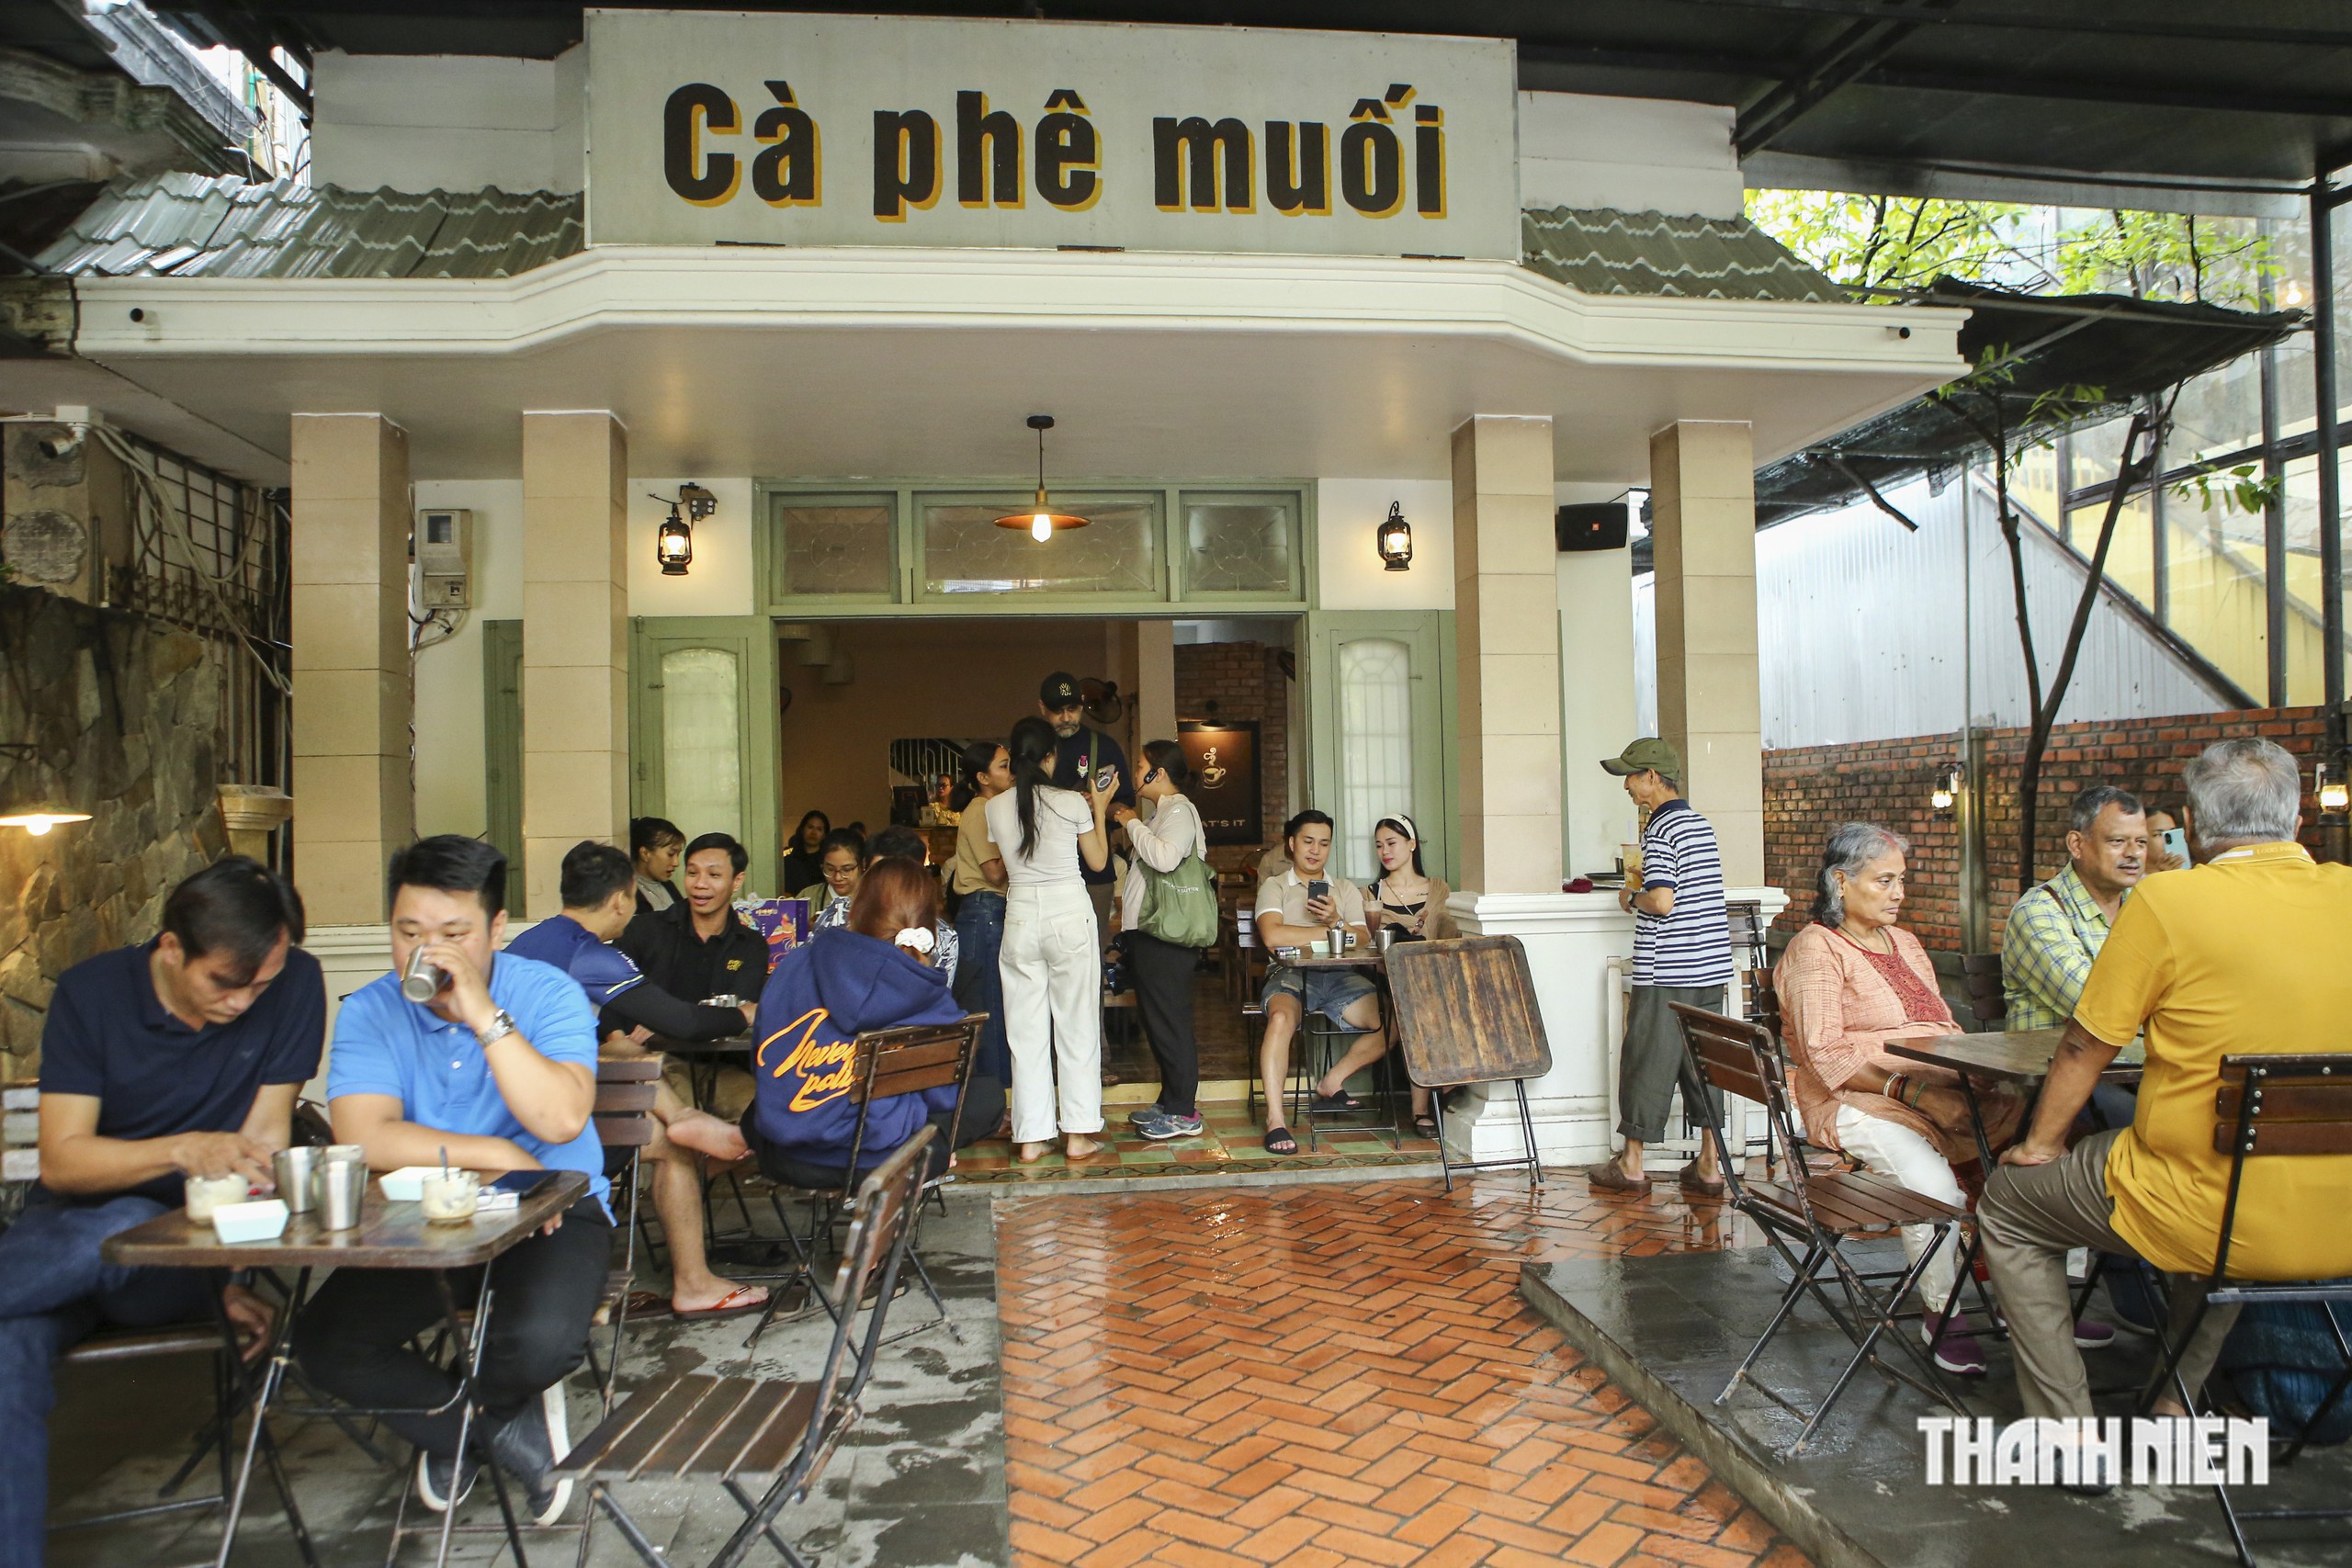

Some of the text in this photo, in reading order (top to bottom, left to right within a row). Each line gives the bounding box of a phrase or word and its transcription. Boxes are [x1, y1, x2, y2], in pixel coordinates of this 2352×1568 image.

[663, 80, 1447, 222] Cà phê muối
